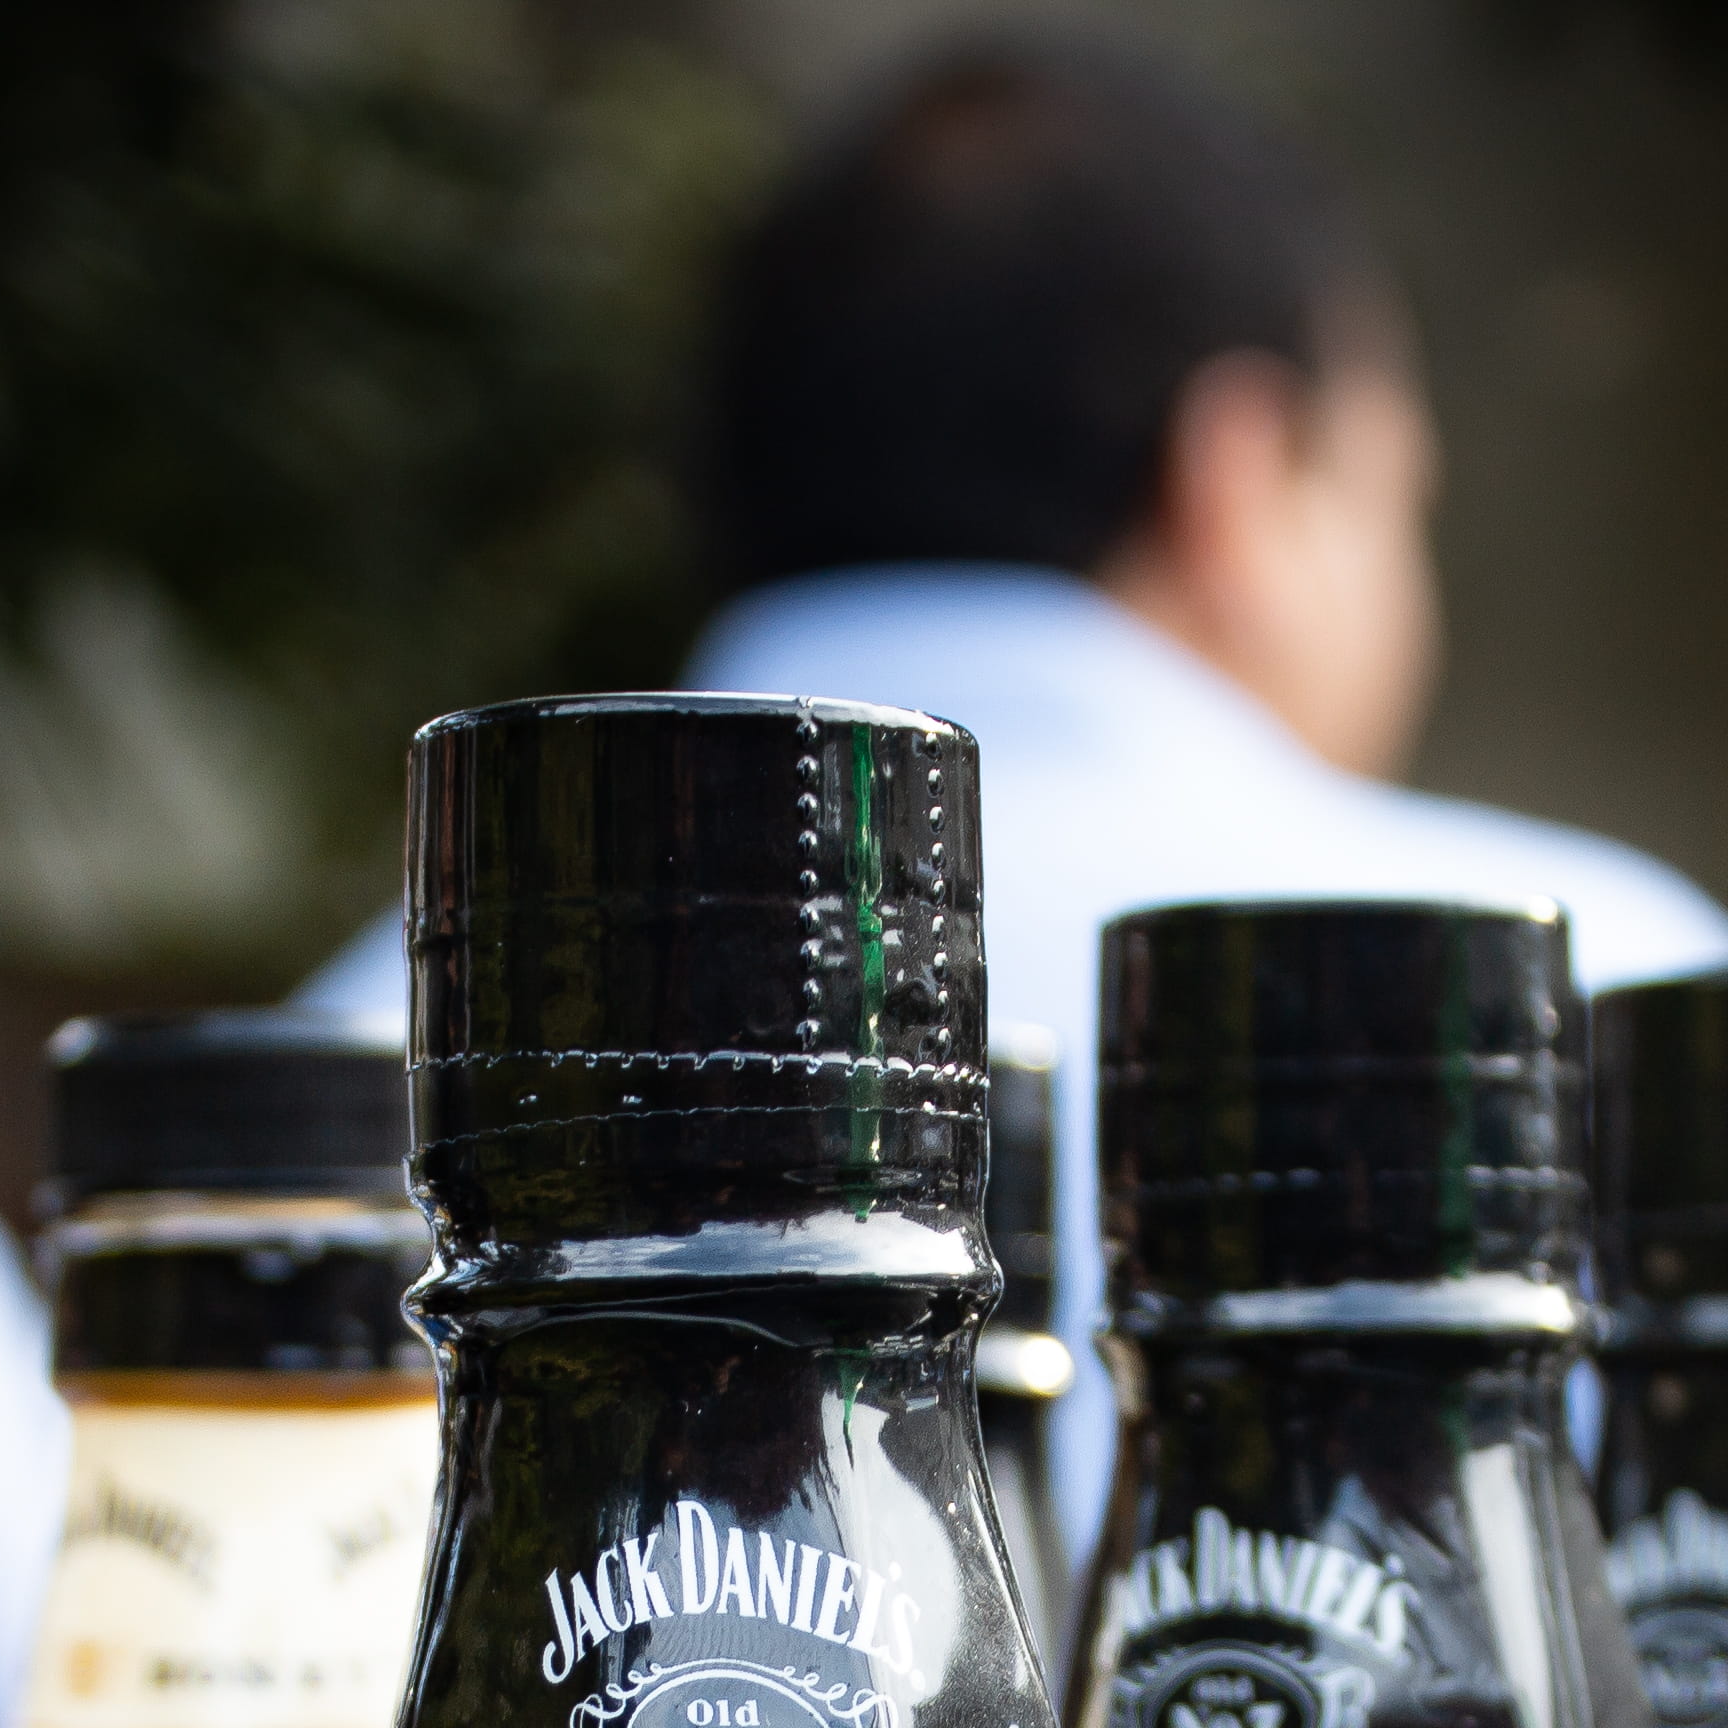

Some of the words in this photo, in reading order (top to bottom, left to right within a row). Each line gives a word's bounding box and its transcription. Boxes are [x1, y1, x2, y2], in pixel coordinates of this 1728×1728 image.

[543, 1513, 673, 1683] JACK
[676, 1500, 926, 1691] DANIEL'S
[687, 1699, 759, 1727] Old
